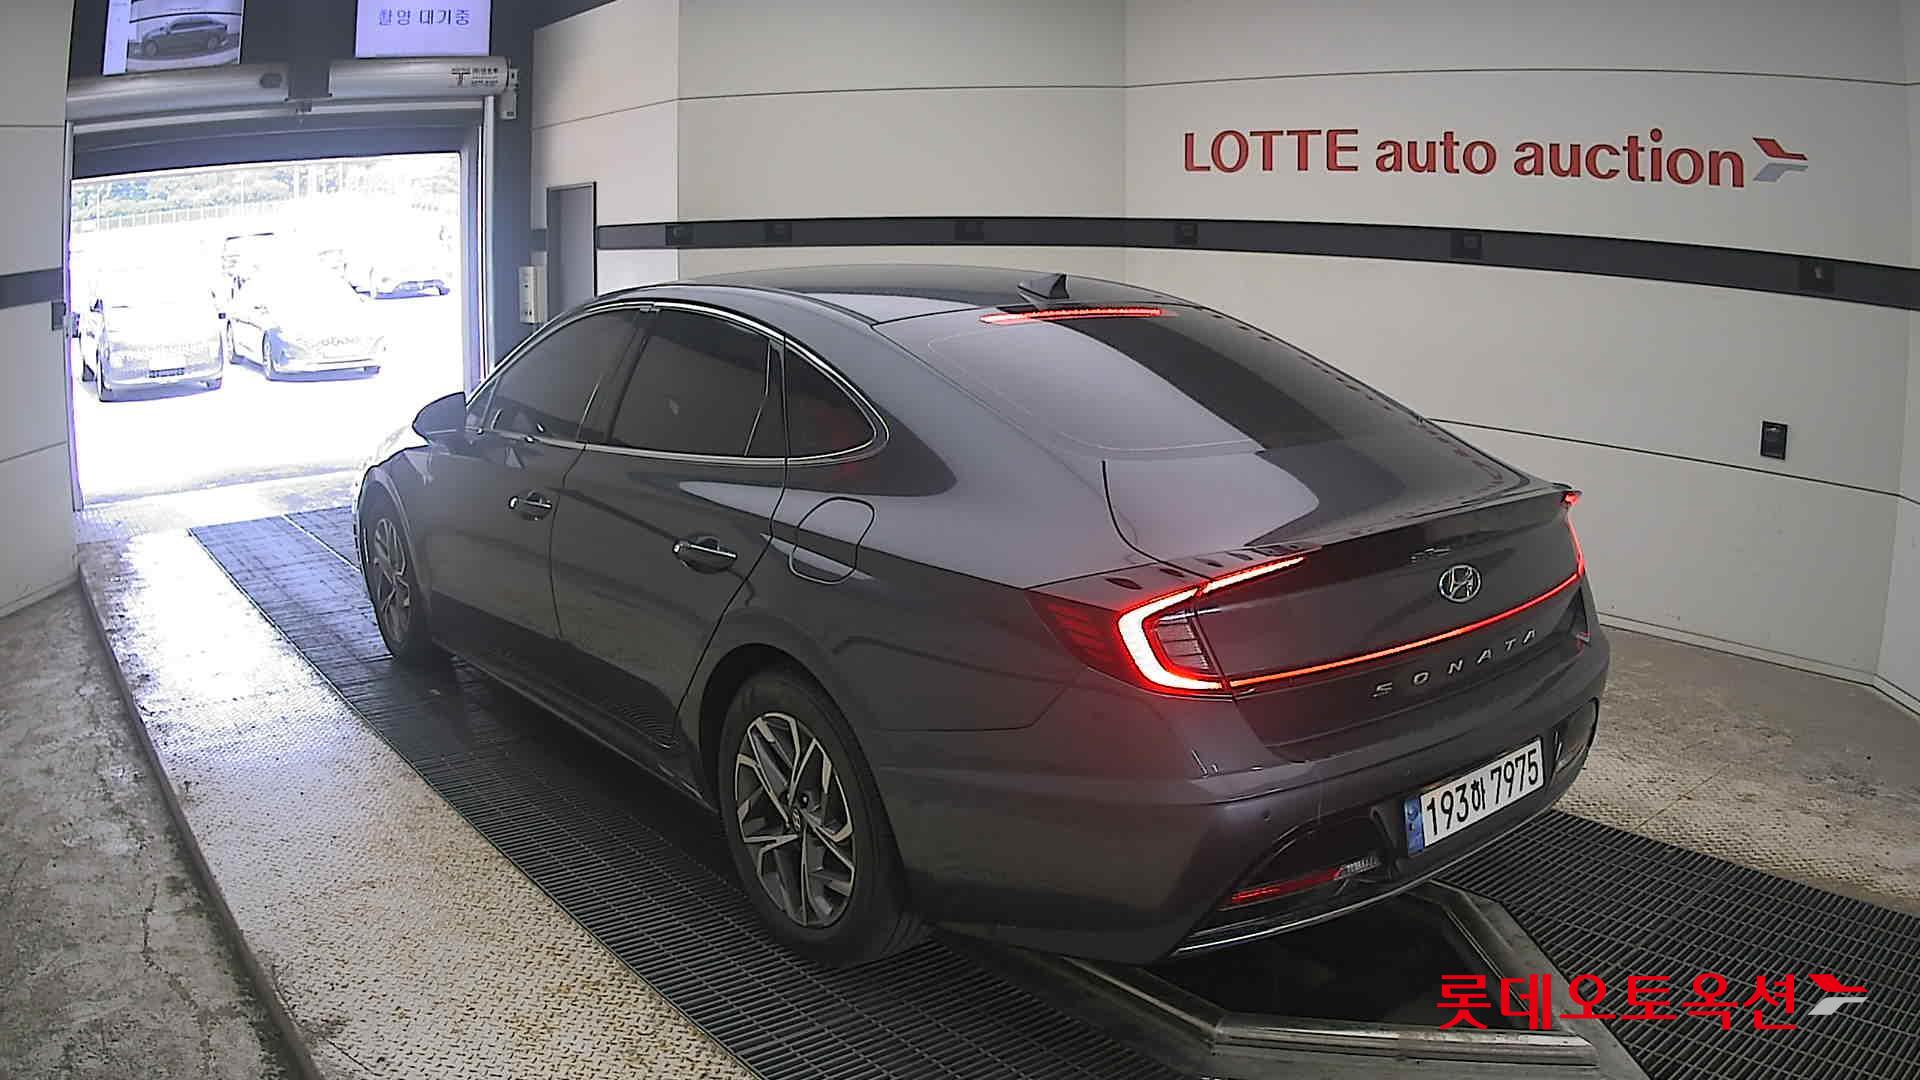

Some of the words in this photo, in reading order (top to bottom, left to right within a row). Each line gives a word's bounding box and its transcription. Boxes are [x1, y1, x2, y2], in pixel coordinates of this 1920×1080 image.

[419, 8, 471, 26] 대기중
[1184, 129, 1359, 173] LOTTE
[1375, 131, 1497, 175] auto
[1513, 128, 1745, 188] auction
[1372, 628, 1537, 698] SONATA
[1426, 777, 1486, 836] 193하
[1490, 749, 1539, 805] 7975
